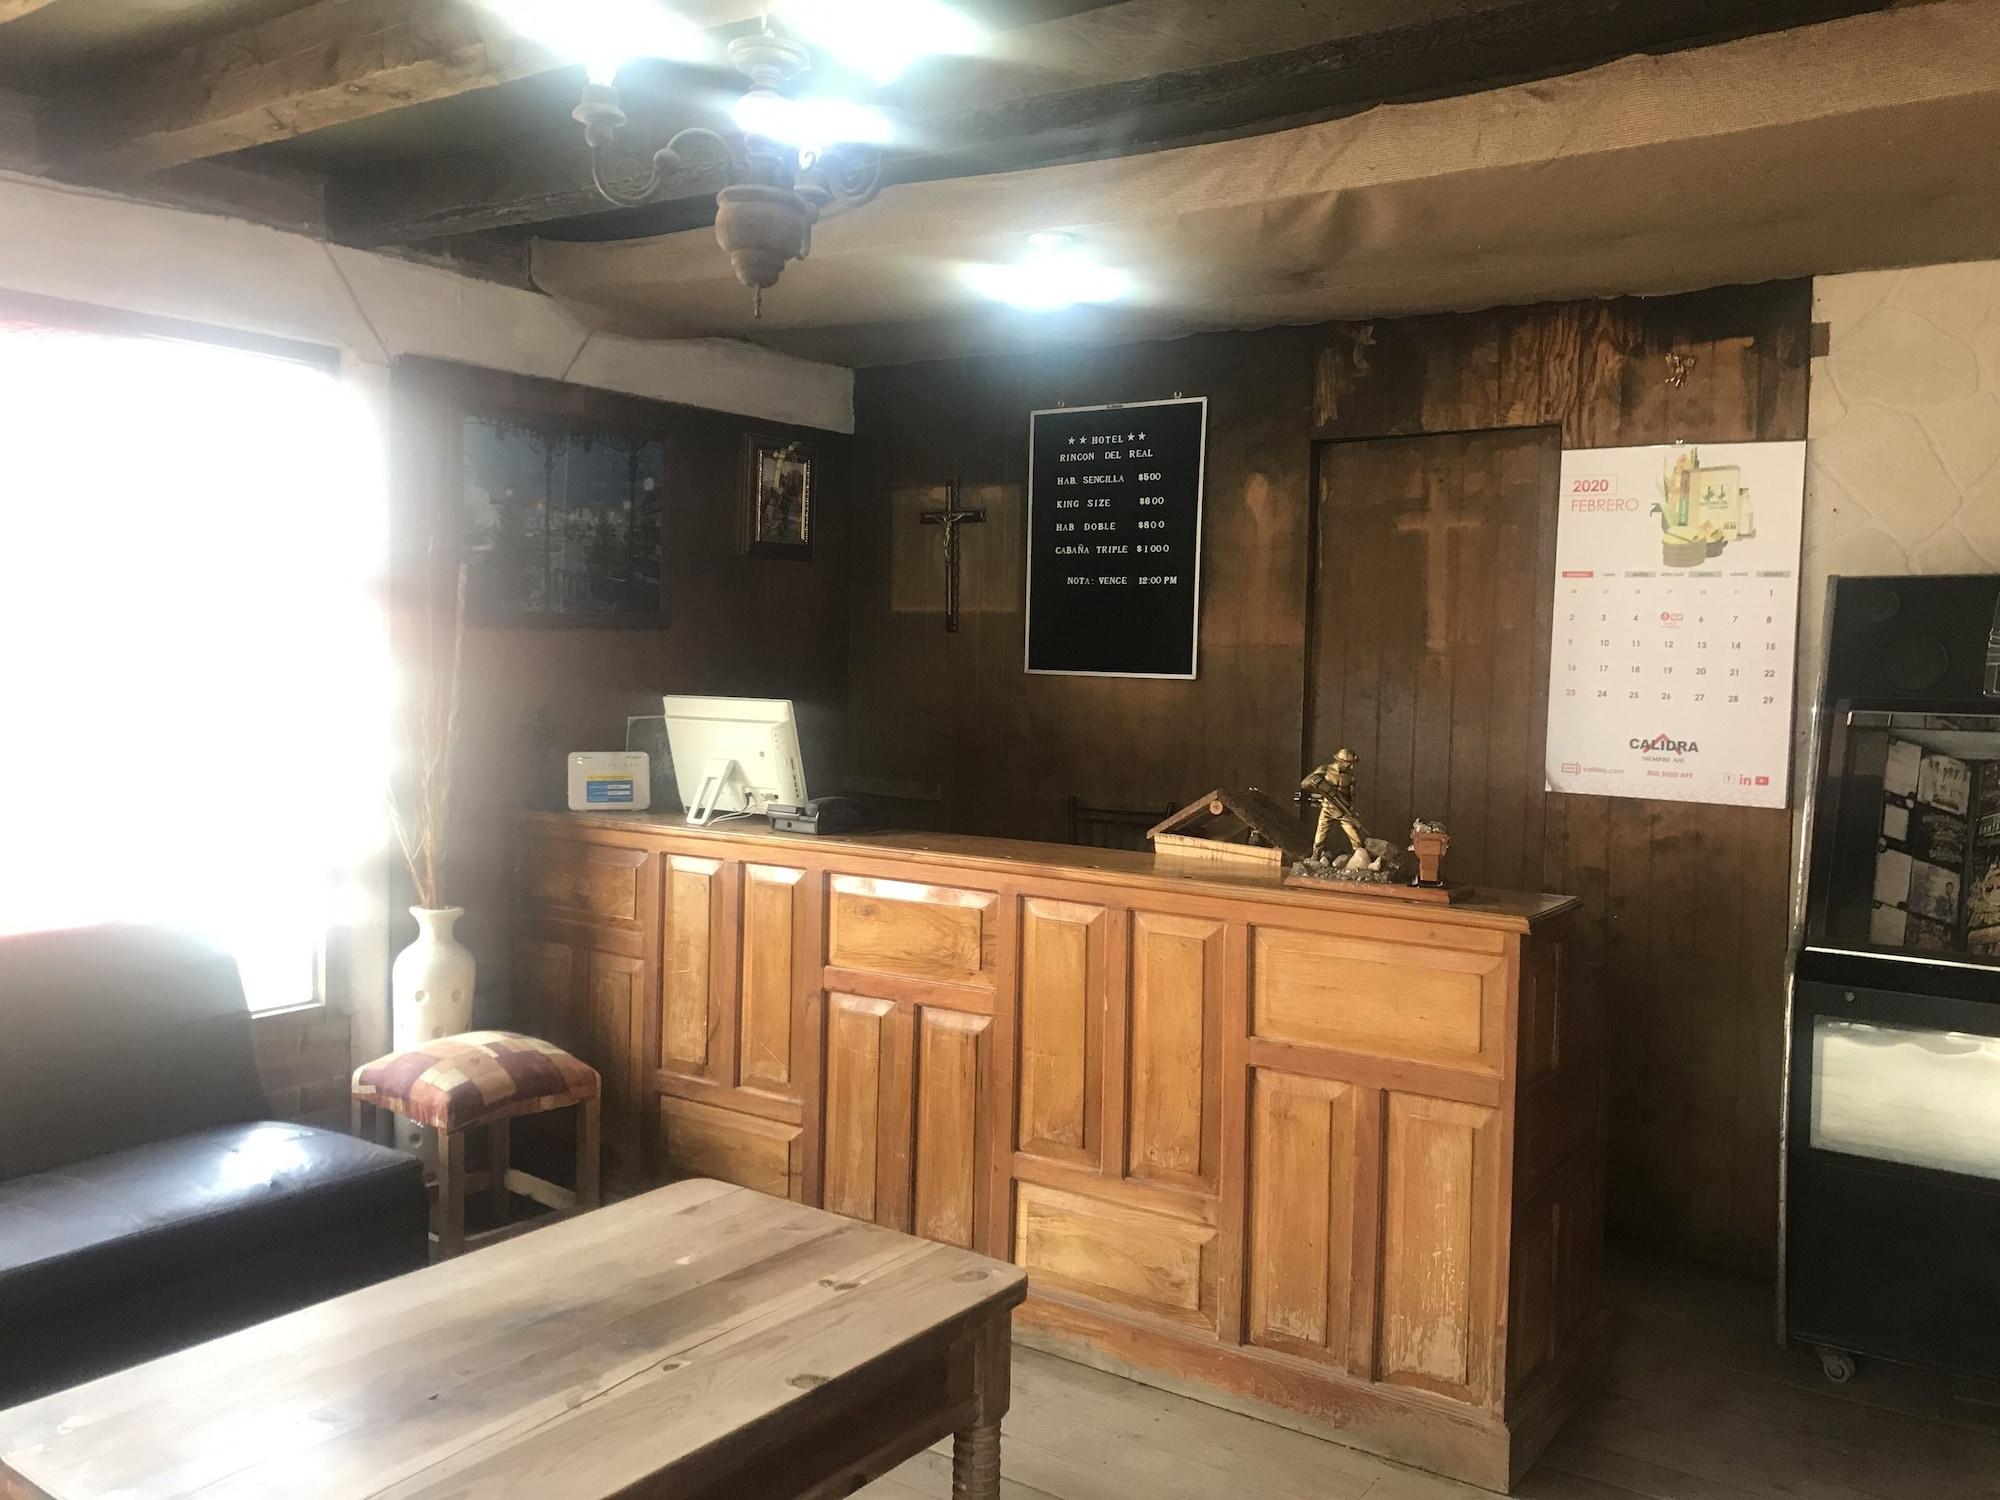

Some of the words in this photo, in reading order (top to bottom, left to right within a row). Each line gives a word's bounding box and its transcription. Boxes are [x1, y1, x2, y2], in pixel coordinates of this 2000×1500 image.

[1091, 435, 1124, 445] HOTEL
[1060, 452, 1095, 462] RINCON
[1105, 451, 1121, 460] DEL
[1129, 449, 1153, 458] REAL
[1082, 475, 1124, 484] SENCILLA
[1138, 472, 1161, 481] $500
[1572, 479, 1609, 493] 2020
[1056, 500, 1079, 509] KING
[1087, 499, 1111, 507] SIZE
[1571, 498, 1639, 512] FEBRERO
[1056, 523, 1075, 531] HAB
[1084, 522, 1116, 531] DOBLE
[1138, 520, 1165, 530] $800
[1055, 544, 1090, 554] CABAÑA
[1096, 545, 1128, 554] TRIPLE
[1067, 577, 1094, 585] NOTA:
[1098, 576, 1127, 585] VENCE
[1138, 576, 1162, 585] 12:00
[1163, 576, 1177, 585] PM
[1732, 615, 1738, 623] 7
[1766, 616, 1772, 624] 8
[1600, 639, 1610, 647] 10
[1664, 640, 1674, 648] 12
[1697, 641, 1707, 649] 13
[1600, 664, 1609, 672] 17
[1631, 665, 1640, 673] 18
[1663, 666, 1673, 674] 19
[1695, 667, 1706, 675] 20
[1729, 668, 1739, 676] 21
[1597, 690, 1608, 698] 24
[1629, 691, 1639, 699] 25
[1661, 692, 1671, 700] 26
[1694, 694, 1705, 702] 27
[1728, 695, 1739, 703] 28
[1762, 696, 1774, 704] 29
